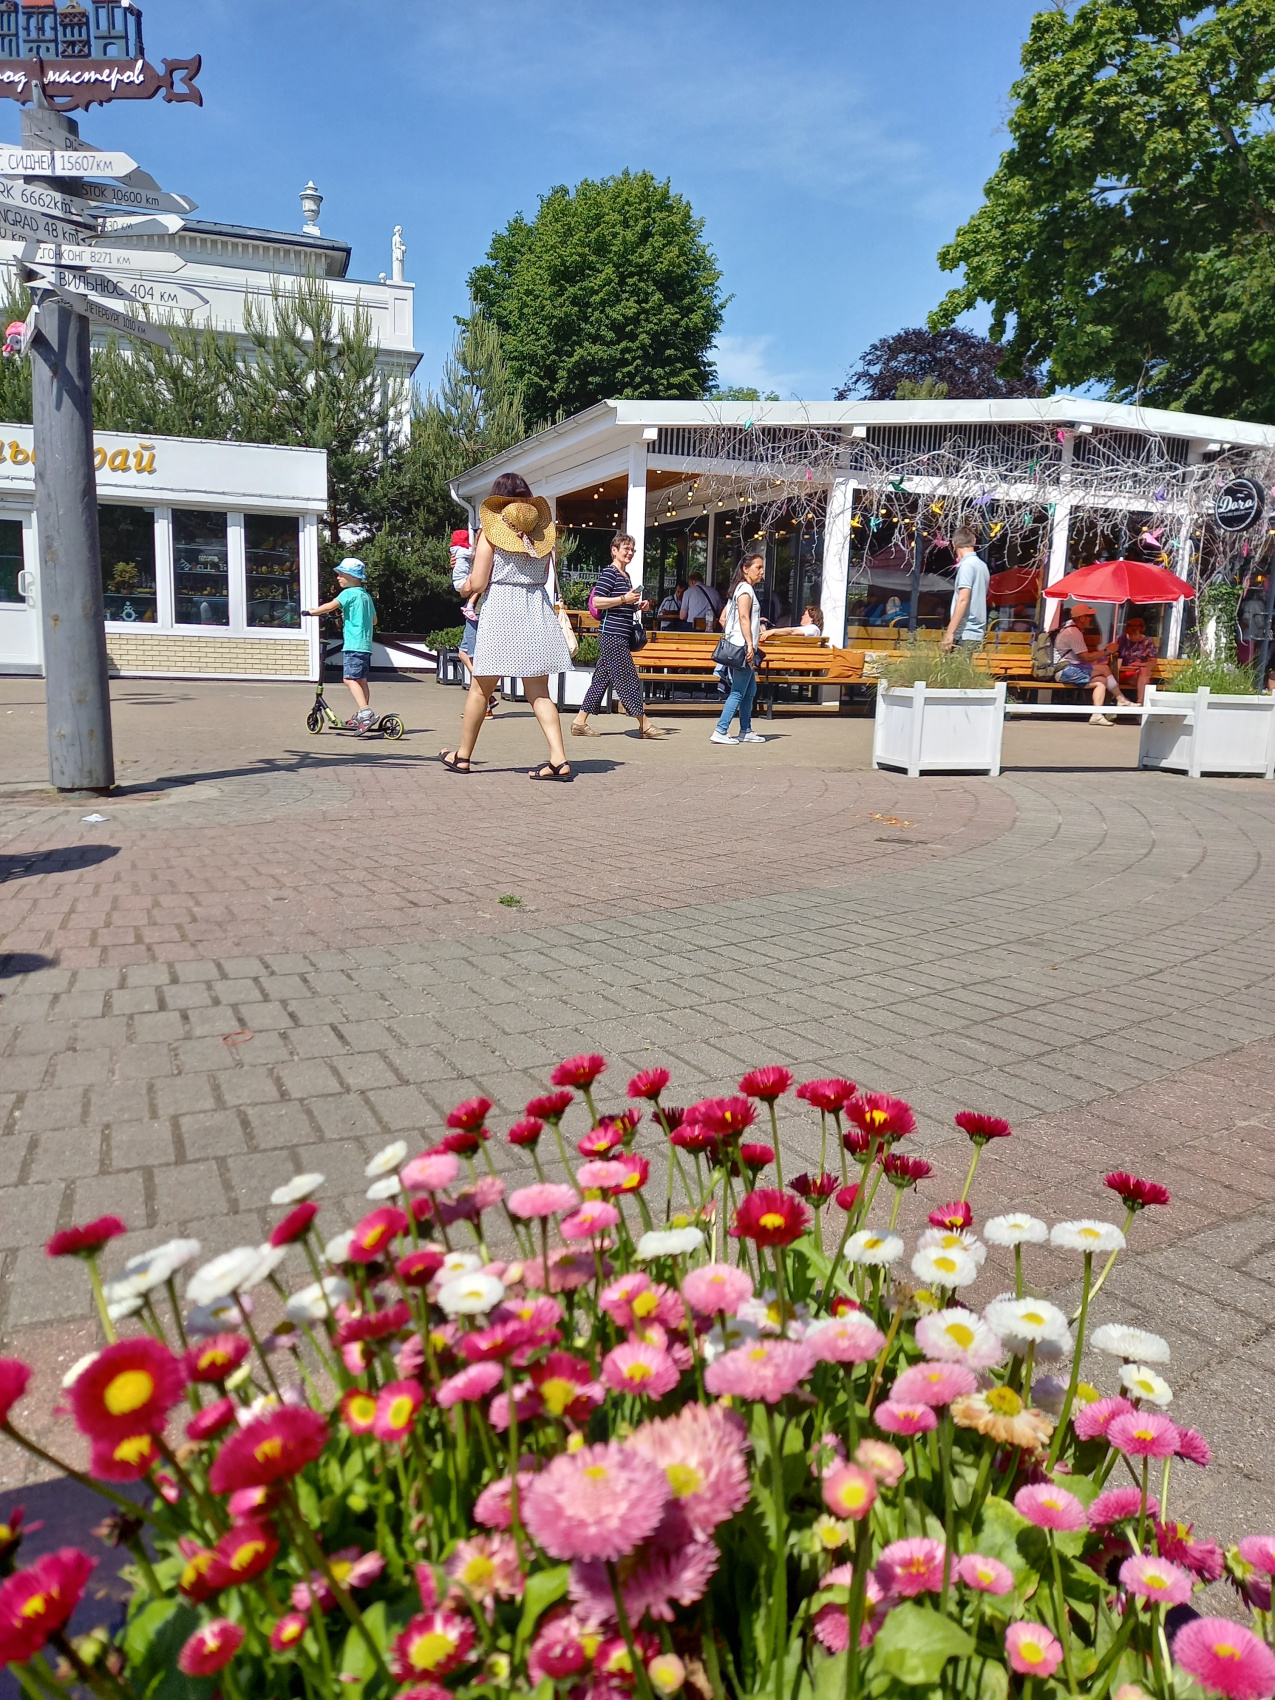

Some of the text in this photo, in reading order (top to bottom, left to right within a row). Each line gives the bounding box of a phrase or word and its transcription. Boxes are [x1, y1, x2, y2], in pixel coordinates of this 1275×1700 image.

[44, 59, 144, 92] мастеров
[112, 188, 142, 204] 10600
[146, 193, 160, 207] km
[44, 221, 59, 239] 48
[62, 226, 78, 244] km
[42, 247, 131, 265] ГОНКОНГ 8271 км
[59, 271, 179, 304] ВИЛЬНЮС 404 км
